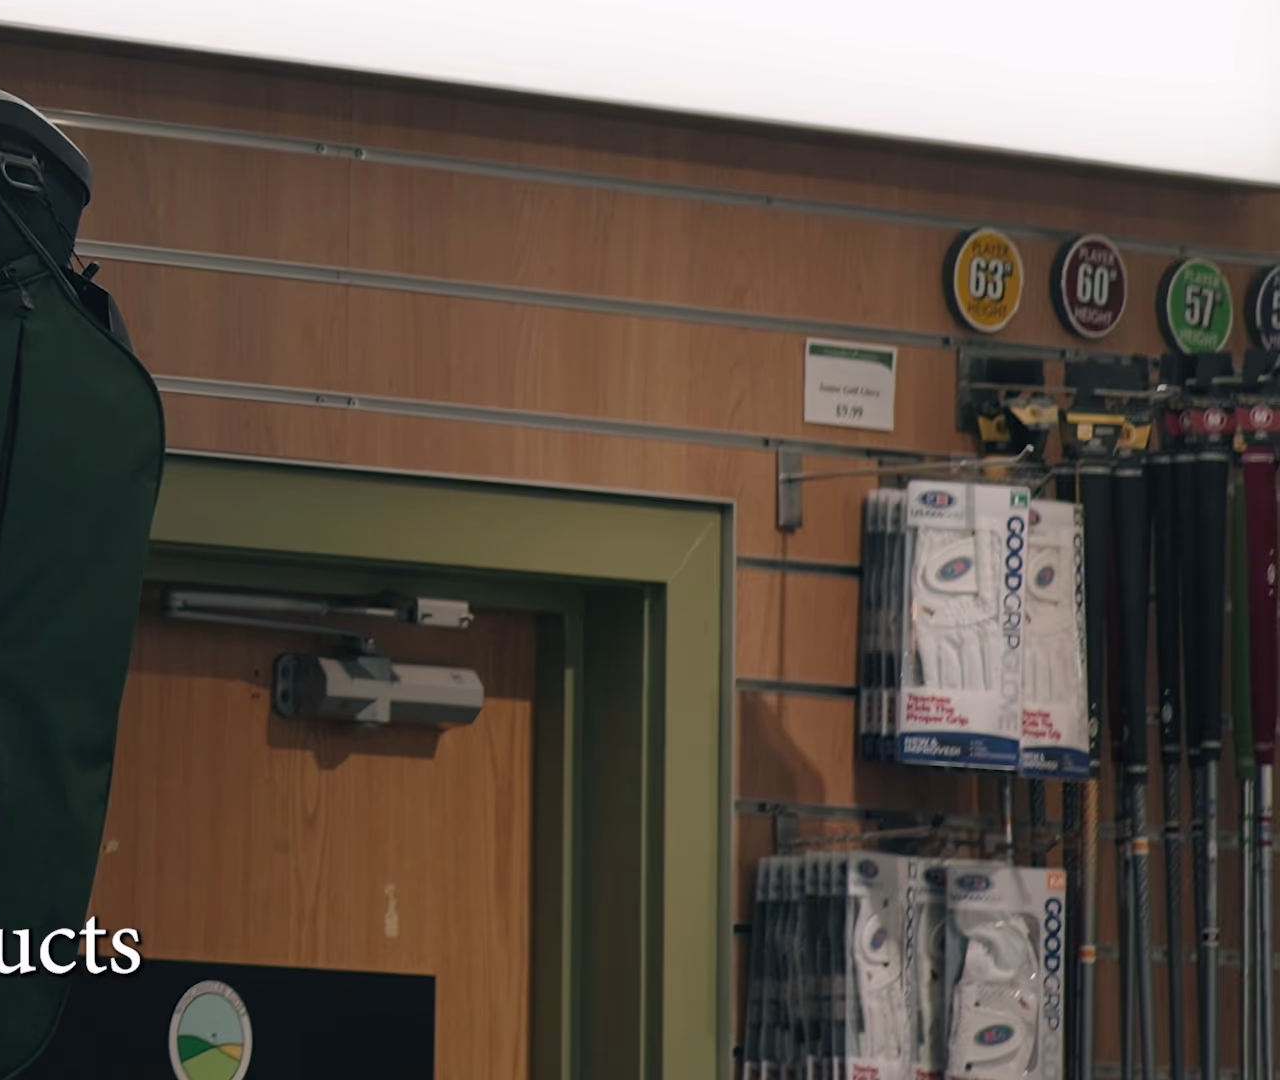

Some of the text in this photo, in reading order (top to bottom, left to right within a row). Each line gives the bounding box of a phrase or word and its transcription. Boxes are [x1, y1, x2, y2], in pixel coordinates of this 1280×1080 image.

[972, 242, 1009, 257] PLAYER
[1079, 247, 1115, 265] PLAYER
[968, 302, 1008, 318] HEIGHT
[1074, 307, 1113, 325] HEIGHT
